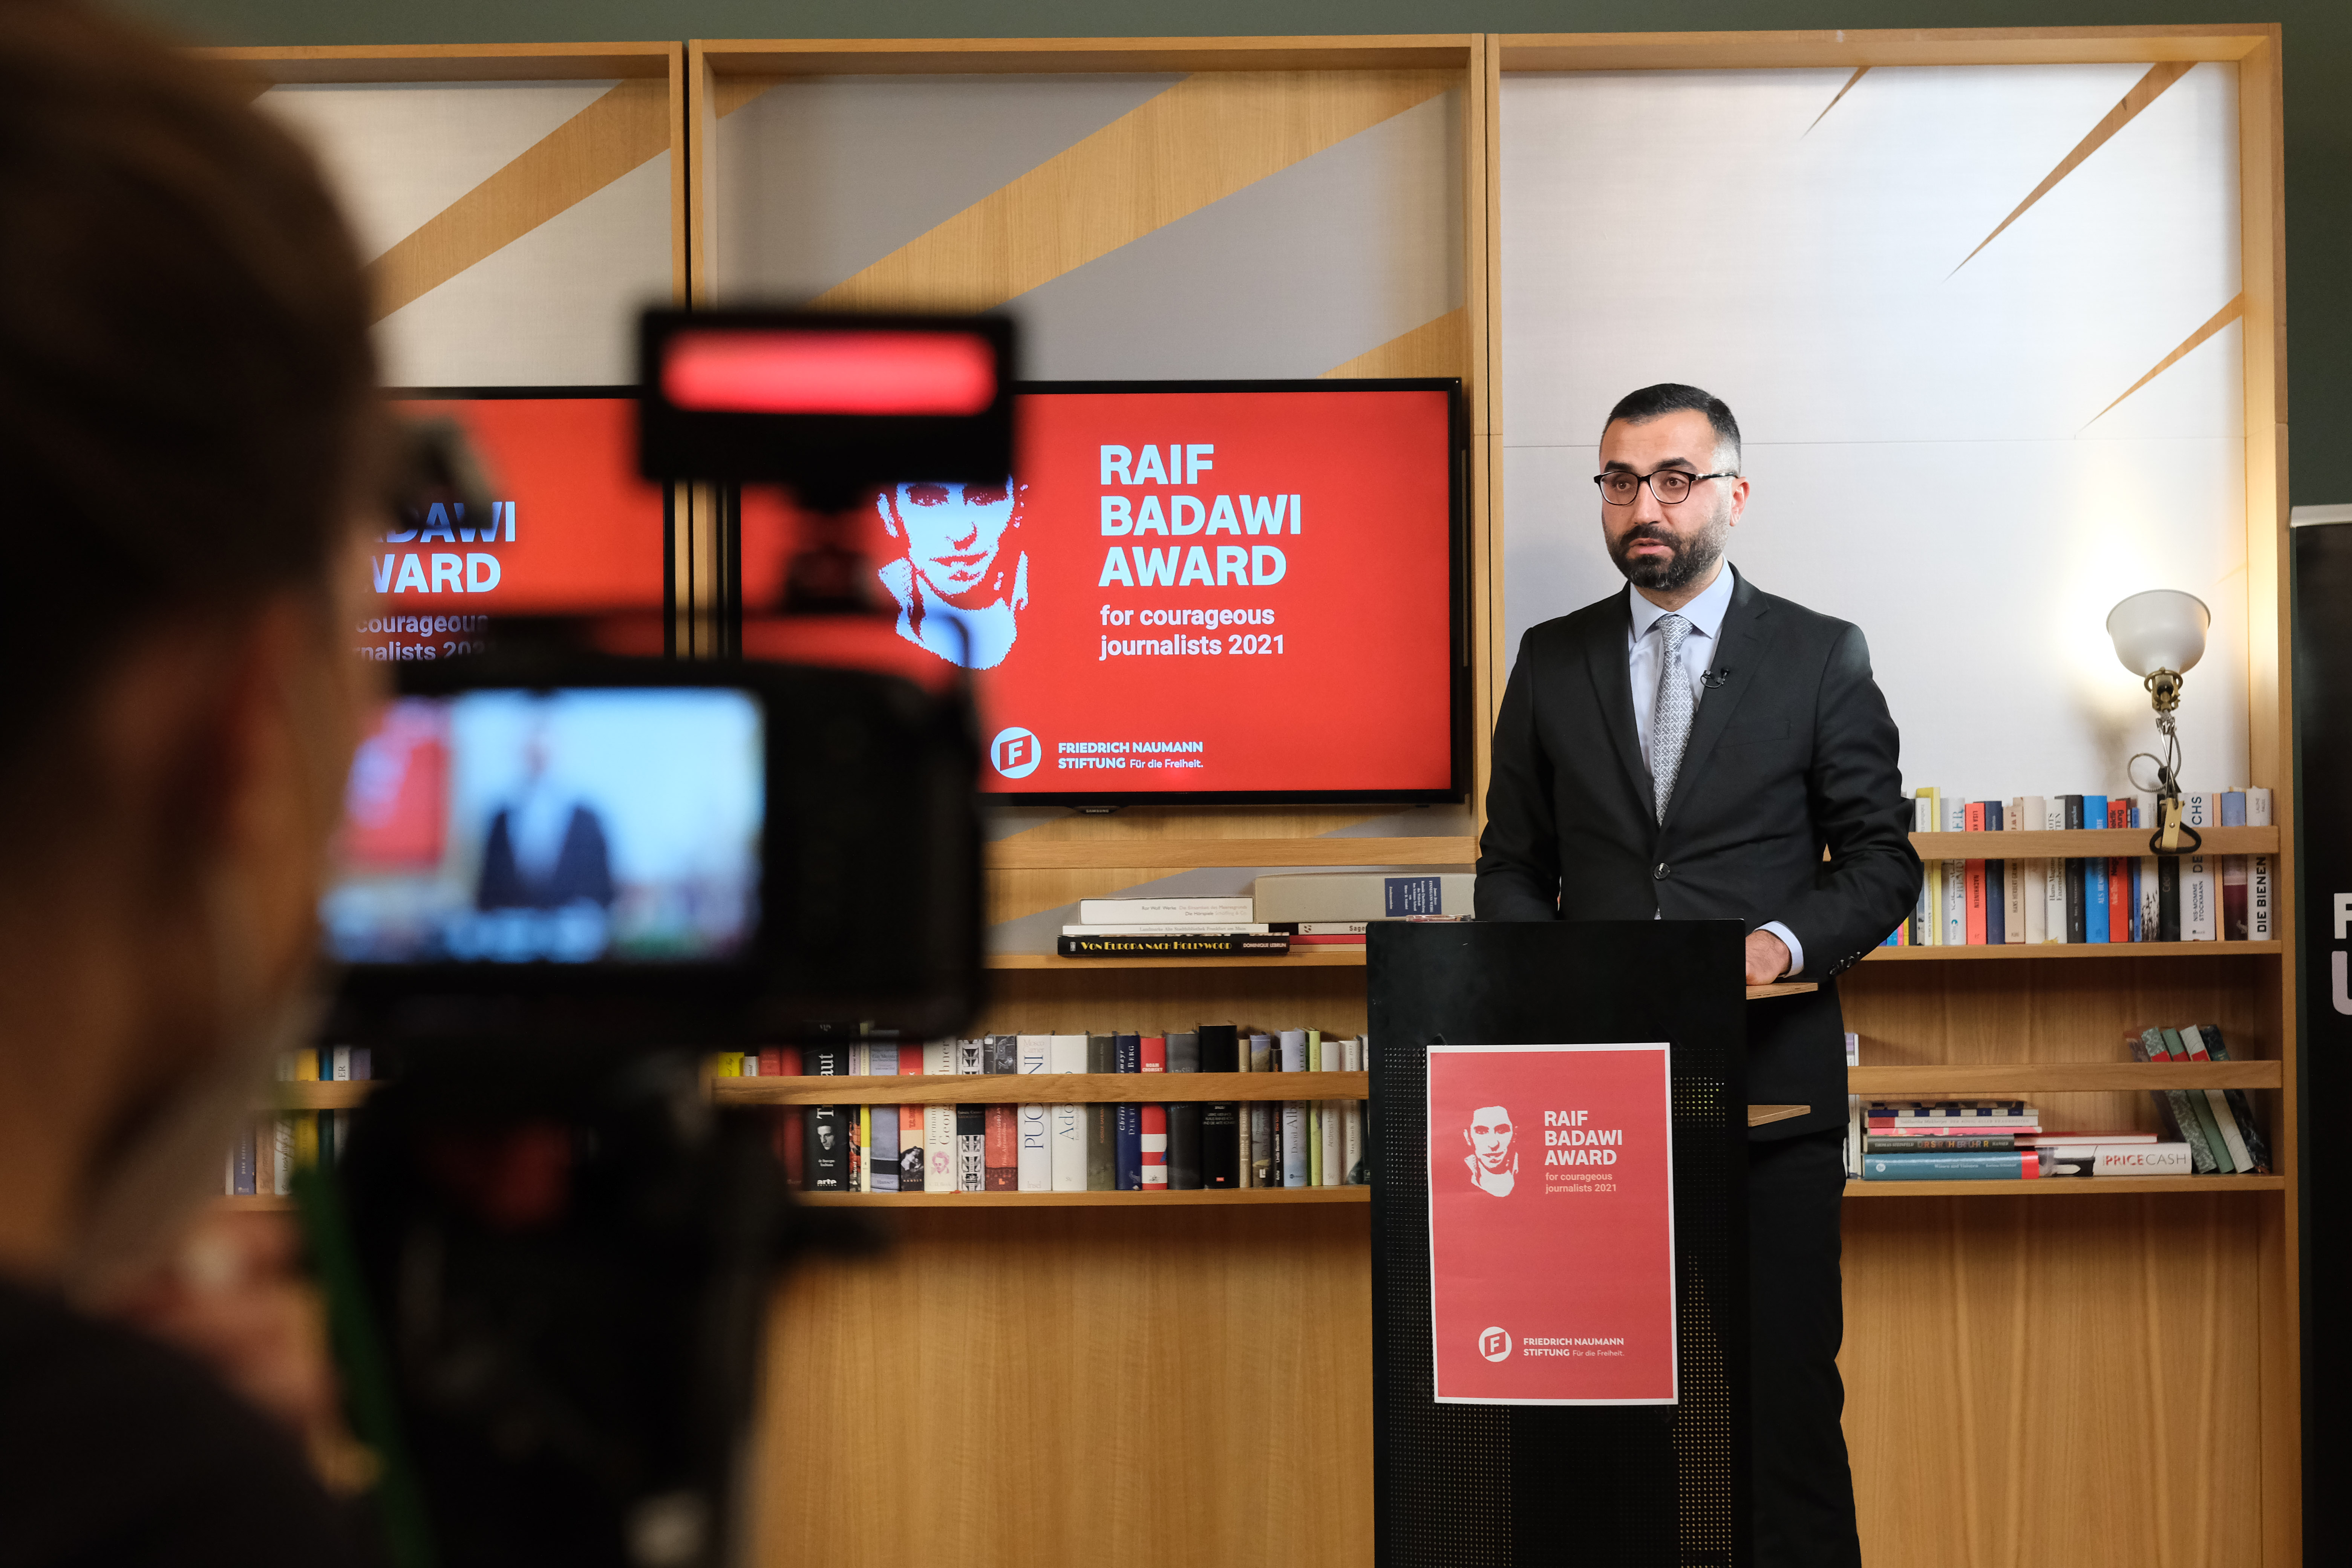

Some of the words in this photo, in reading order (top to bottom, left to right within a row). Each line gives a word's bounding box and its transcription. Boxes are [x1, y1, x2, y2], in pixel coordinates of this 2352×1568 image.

[1101, 444, 1214, 485] RAIF
[1101, 495, 1301, 536] BADAWI
[372, 553, 501, 593] WARD
[1098, 545, 1286, 587] AWARD
[1100, 605, 1134, 626] for
[1139, 609, 1275, 630] courageous
[1099, 634, 1222, 661] journalists
[1228, 634, 1283, 655] 2021
[1058, 742, 1130, 753] FRIEDRICH
[1132, 741, 1203, 753] NAUMANN
[1058, 757, 1126, 769] STIFTUNG
[1130, 759, 1146, 768] Für
[1148, 759, 1162, 768] die
[1165, 759, 1204, 768] Freiheit.
[2256, 857, 2266, 907] BIENEN
[2257, 912, 2266, 933] DIE
[1104, 942, 1144, 950] EUROPA
[939, 1104, 954, 1145] Georg
[1544, 1111, 1588, 1126] RAIF
[1545, 1130, 1622, 1146] BADAWI
[1544, 1150, 1617, 1165] AWARD
[1560, 1173, 1612, 1182] courageous
[1545, 1184, 1592, 1194] journalists
